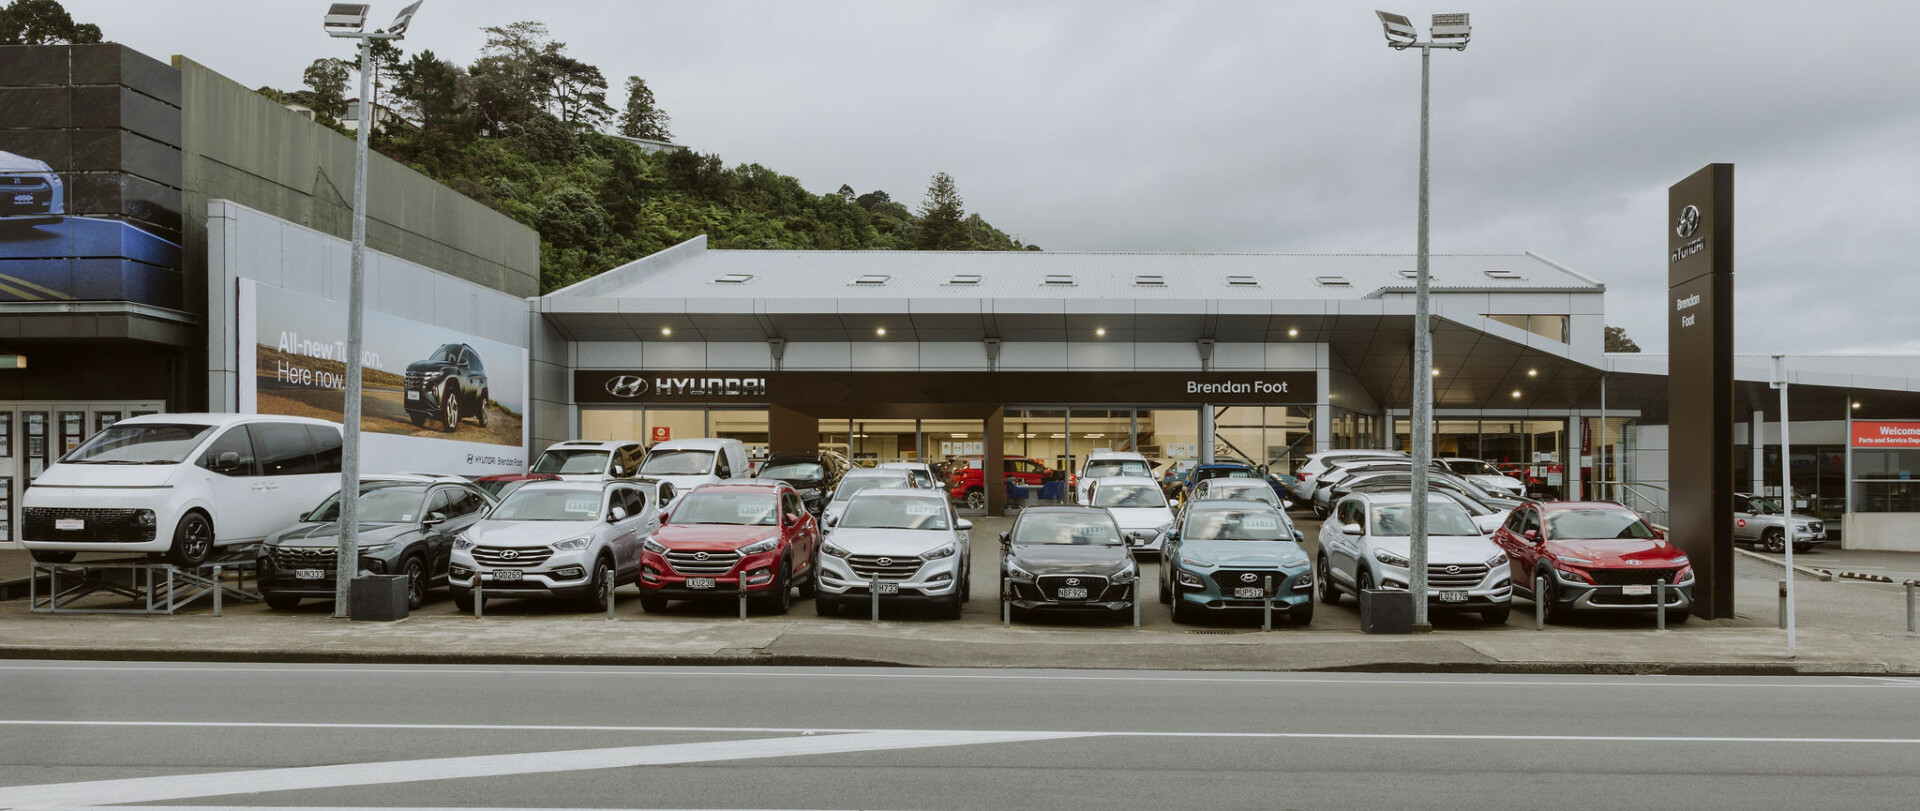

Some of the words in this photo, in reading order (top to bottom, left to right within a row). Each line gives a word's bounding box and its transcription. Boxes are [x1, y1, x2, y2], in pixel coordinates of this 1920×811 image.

[1676, 294, 1700, 311] Brendan
[1681, 314, 1696, 328] Foot
[278, 331, 333, 360] All-new
[335, 342, 383, 369] Tuon.
[277, 360, 312, 386] Here
[315, 371, 346, 389] now.
[655, 377, 766, 396] HYUNDAI
[1187, 380, 1251, 393] Brendan
[1254, 381, 1288, 393] Foot
[1879, 426, 1920, 436] Welcome
[296, 570, 324, 578] NUN333
[687, 579, 715, 587] LKU238
[1235, 589, 1263, 597] MUP512
